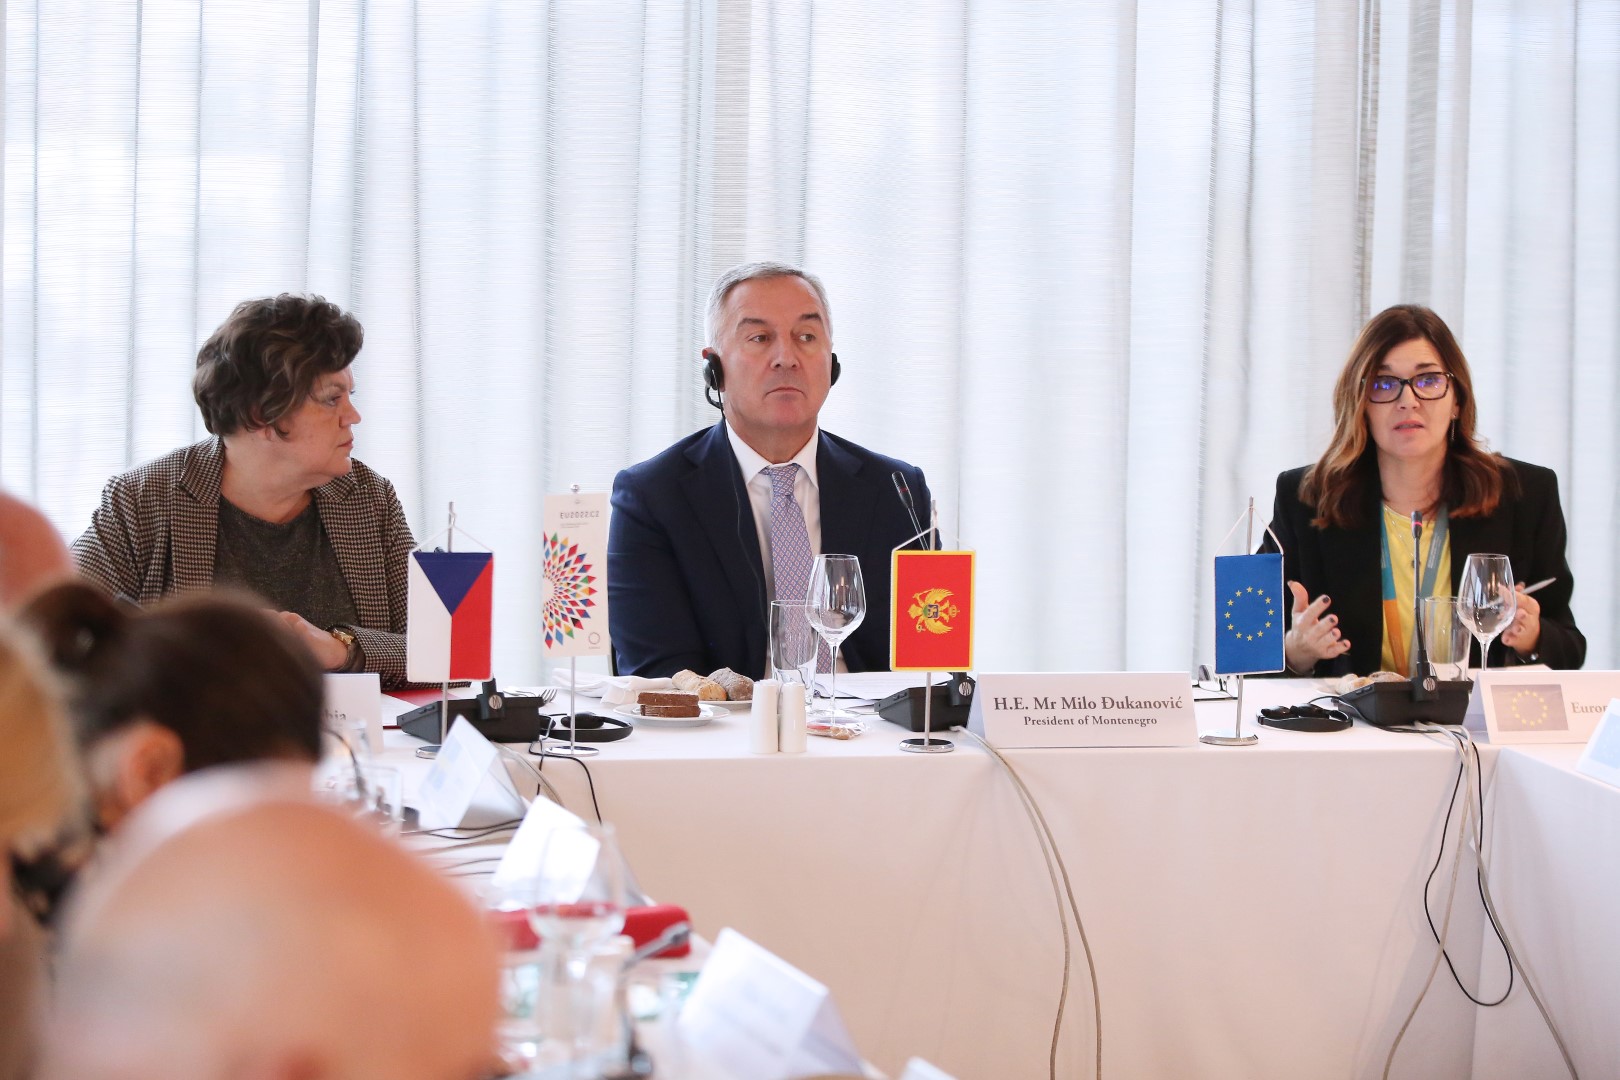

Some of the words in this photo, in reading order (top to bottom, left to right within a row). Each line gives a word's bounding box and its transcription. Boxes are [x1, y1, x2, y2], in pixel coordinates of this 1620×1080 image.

[994, 697, 1030, 710] H.E.
[1033, 697, 1057, 710] Mr
[1060, 696, 1097, 710] Milo
[1101, 696, 1183, 710] Đukanović
[1023, 716, 1075, 727] President
[1078, 715, 1091, 726] of
[1092, 715, 1158, 728] Montenegro
